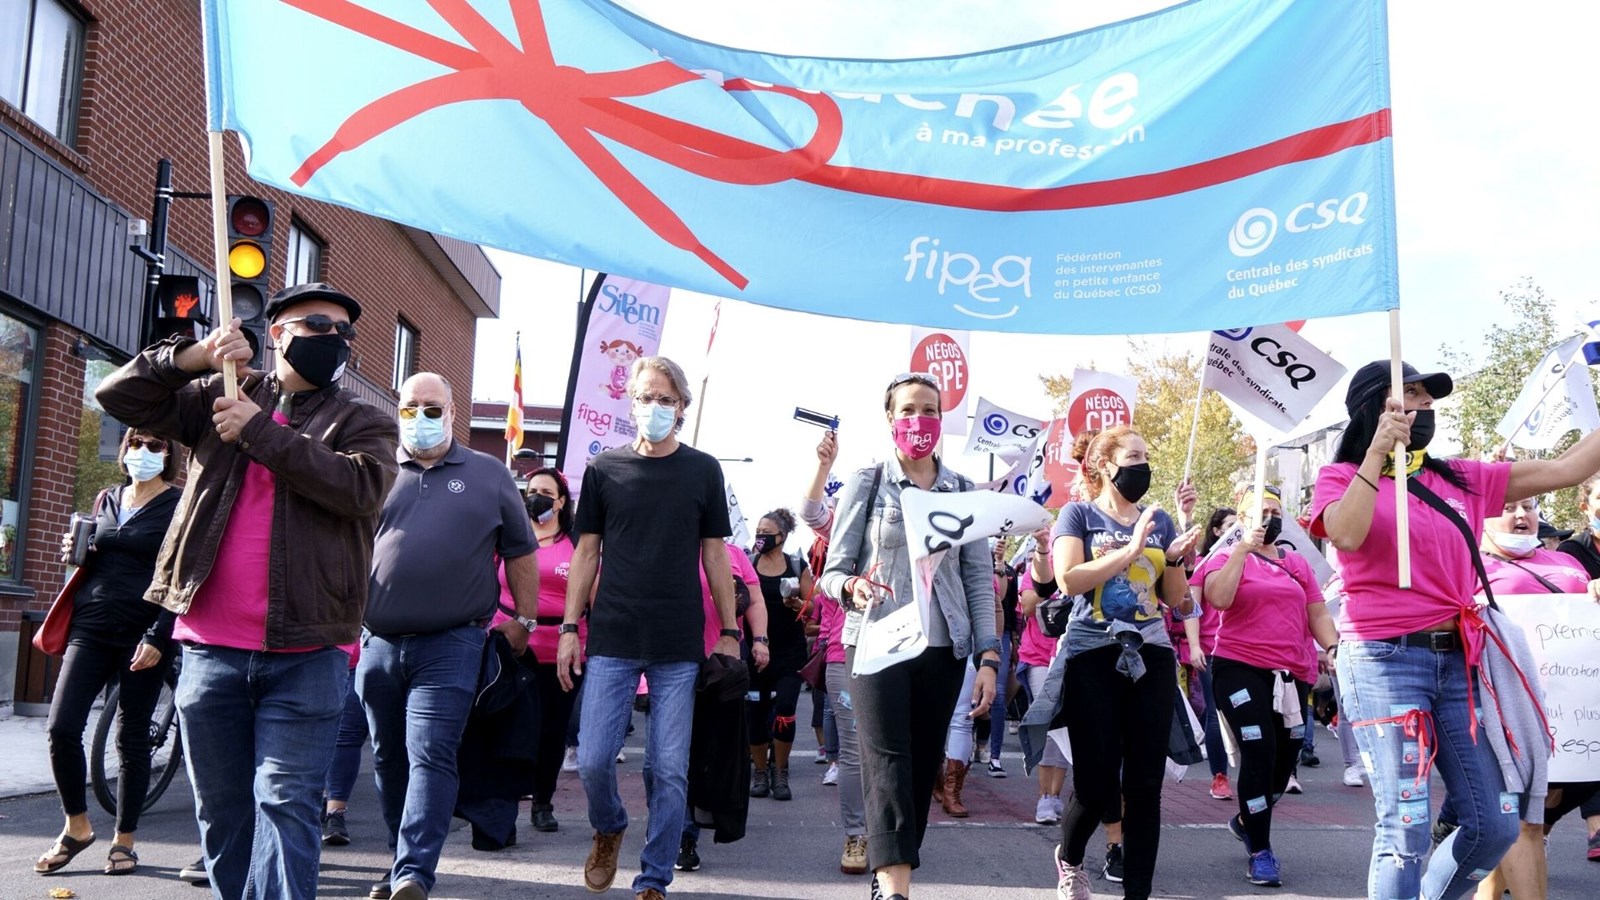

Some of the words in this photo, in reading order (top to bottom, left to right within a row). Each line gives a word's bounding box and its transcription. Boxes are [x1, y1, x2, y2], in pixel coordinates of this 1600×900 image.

[915, 122, 932, 142] à
[941, 128, 986, 148] ma
[1285, 191, 1369, 233] CSQ
[1056, 250, 1121, 263] Fédération
[1226, 262, 1281, 282] Centrale
[1285, 259, 1309, 273] des
[1312, 243, 1374, 269] syndicats
[1055, 265, 1077, 275] des
[1080, 258, 1163, 274] intervenantes
[1054, 278, 1069, 287] en
[1072, 275, 1109, 288] petite
[1112, 271, 1160, 285] enfance
[1227, 286, 1245, 299] du
[1248, 277, 1299, 297] Québec
[1054, 289, 1070, 299] du
[1073, 288, 1121, 299] Québec
[1124, 283, 1162, 297] (CSQ)
[925, 340, 961, 361] NÉGOS
[1231, 359, 1246, 376] des
[1250, 337, 1316, 390] CSQ
[928, 361, 963, 391] CPE
[1085, 393, 1124, 411] NÉGOS
[1012, 424, 1040, 439] CS
[1093, 531, 1113, 544] We
[1114, 530, 1135, 542] Ca
